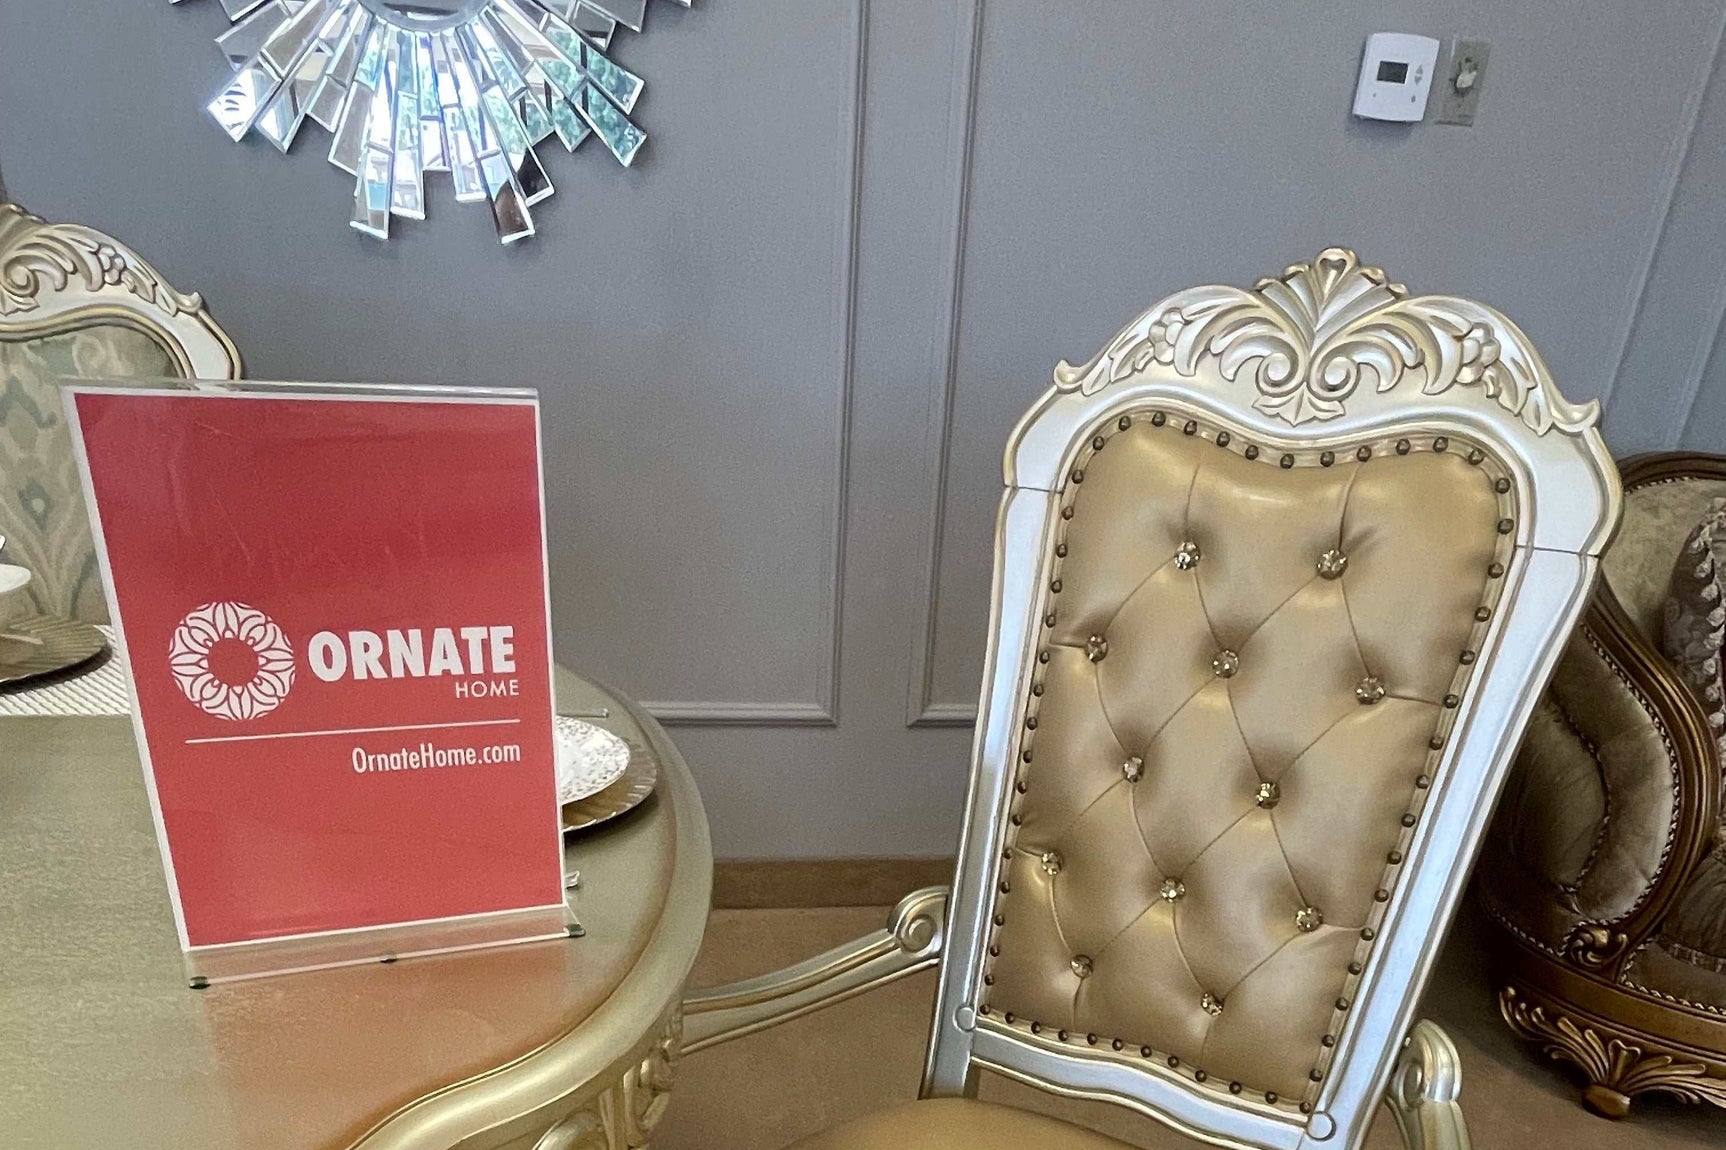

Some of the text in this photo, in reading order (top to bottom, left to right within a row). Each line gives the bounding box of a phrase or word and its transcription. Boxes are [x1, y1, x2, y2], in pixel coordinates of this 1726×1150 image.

[308, 626, 516, 682] ORNATE
[455, 679, 520, 698] HOME
[351, 743, 521, 773] OrnateHome.com
